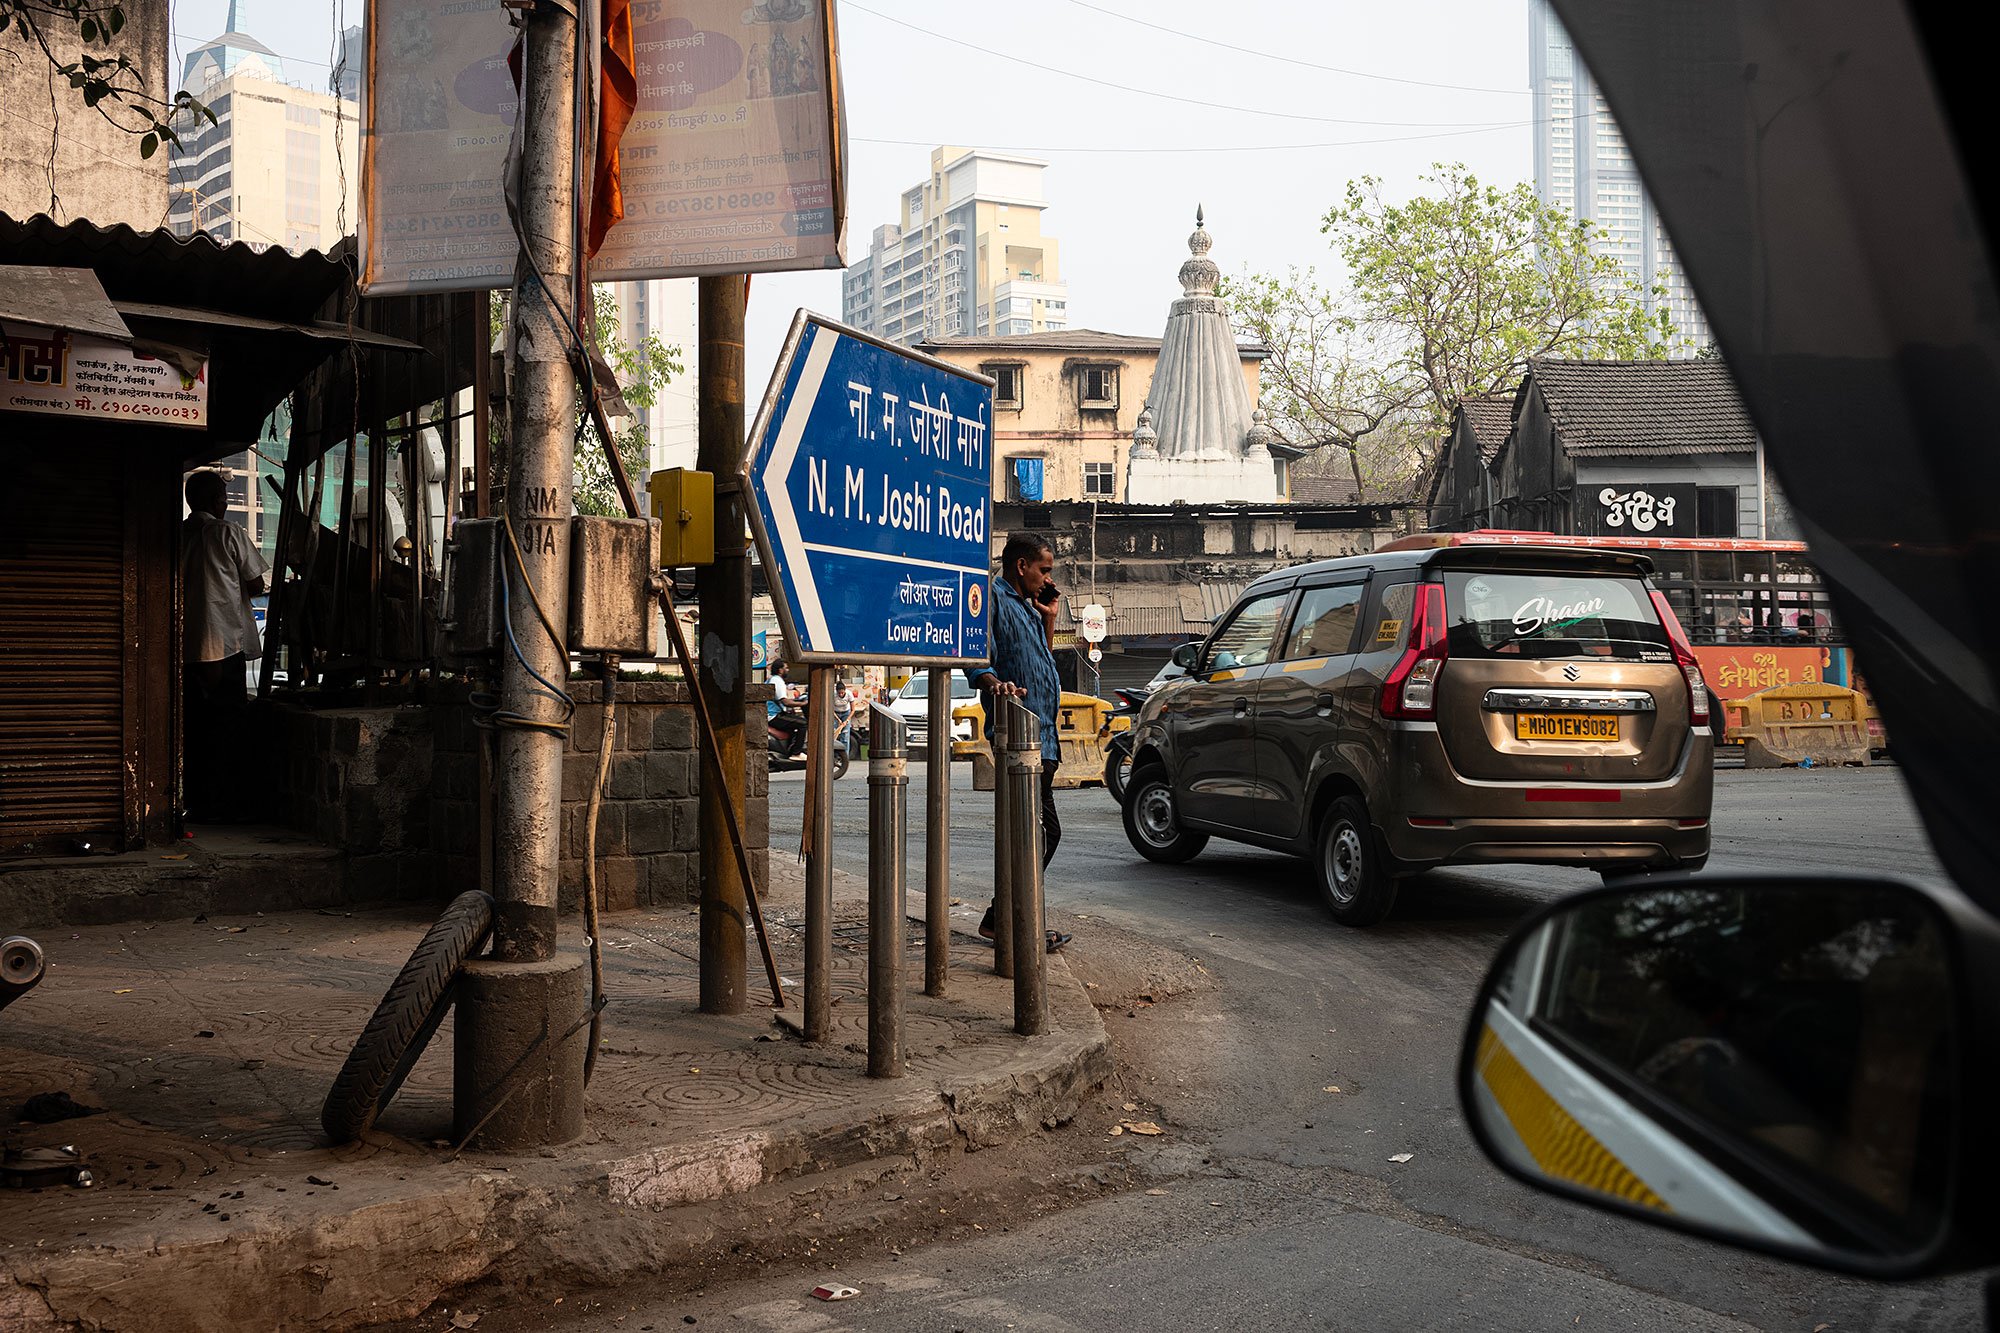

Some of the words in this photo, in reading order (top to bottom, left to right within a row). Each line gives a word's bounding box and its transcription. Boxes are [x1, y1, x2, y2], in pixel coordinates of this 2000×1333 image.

[75, 395, 97, 411] मो.
[848, 380, 875, 441] ना.
[881, 391, 902, 448] म.
[908, 382, 954, 462] जोशी
[956, 402, 987, 470] मार्ग
[525, 487, 557, 513] NM
[808, 455, 835, 518] N.
[845, 464, 871, 525] M.
[878, 473, 931, 534] Joshi
[938, 486, 985, 544] Road
[1599, 488, 1676, 532] उत्सव
[899, 573, 931, 606] लोअर
[931, 584, 955, 608] परळ
[887, 618, 922, 643] Lower
[925, 621, 955, 645] Parel
[1512, 597, 1605, 635] Shaan
[1528, 717, 1618, 737] MH01EW9082
